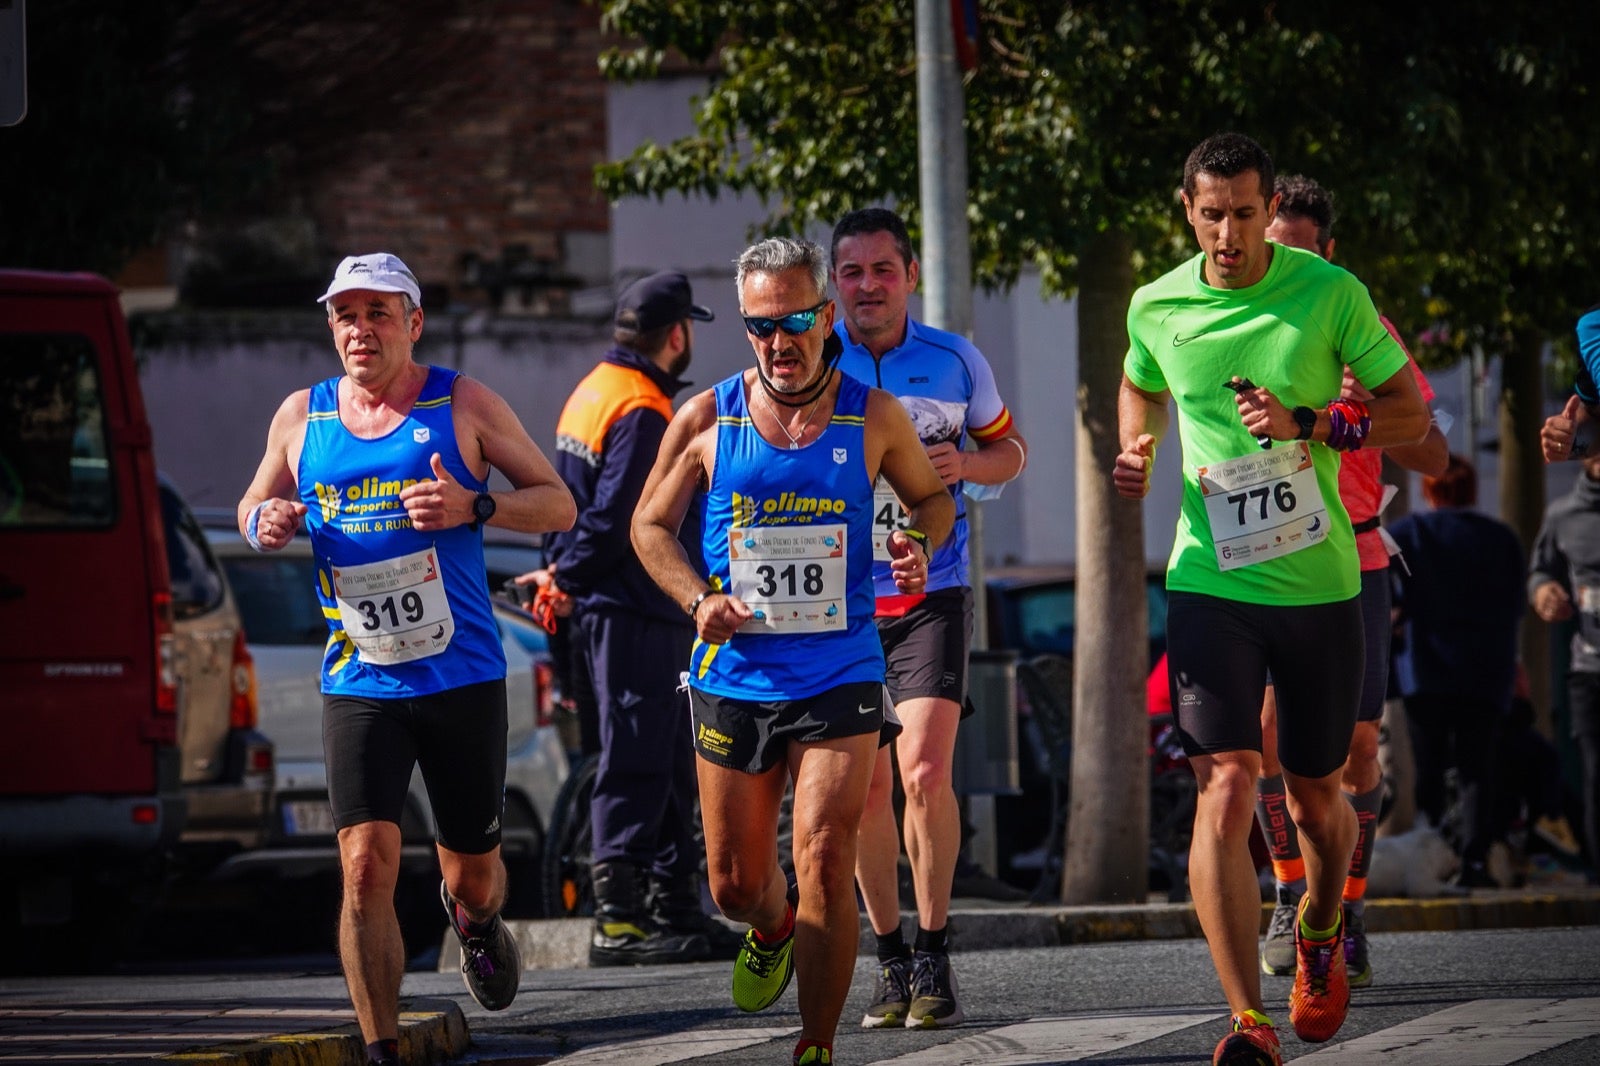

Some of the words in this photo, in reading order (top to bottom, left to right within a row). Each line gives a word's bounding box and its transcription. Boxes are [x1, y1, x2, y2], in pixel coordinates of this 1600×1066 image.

[345, 500, 399, 515] deportes
[763, 492, 846, 517] olimpo
[1227, 482, 1296, 526] 776
[341, 522, 371, 534] TRAIL
[374, 522, 383, 531] &
[759, 515, 813, 525] deportes
[756, 563, 824, 597] 318
[358, 591, 424, 631] 319
[705, 728, 733, 744] olimpo
